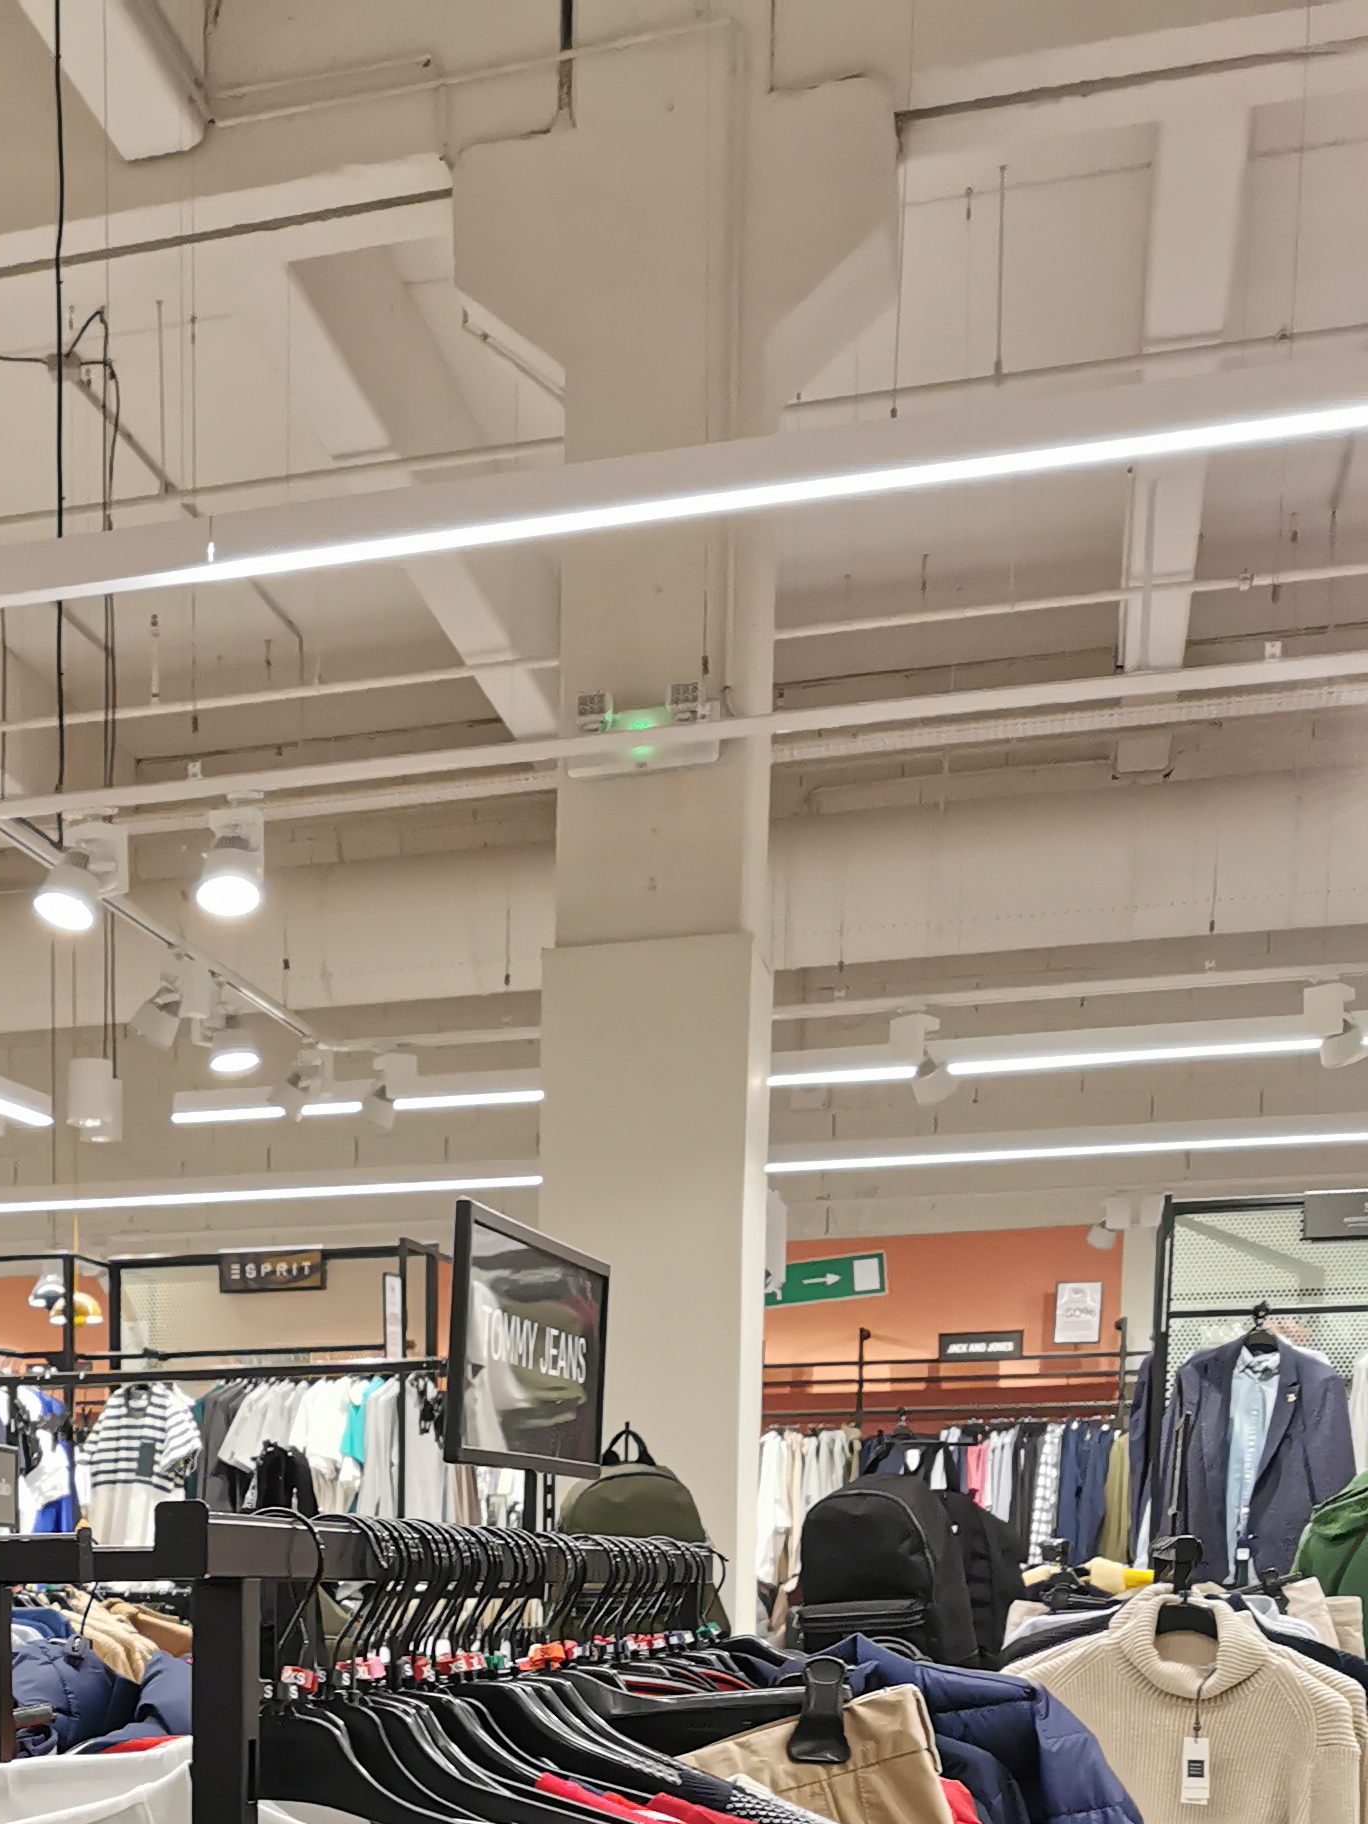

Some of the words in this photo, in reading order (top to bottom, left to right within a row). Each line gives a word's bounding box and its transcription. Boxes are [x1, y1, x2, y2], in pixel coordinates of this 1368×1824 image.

[231, 1261, 312, 1280] ESPRIT
[482, 1305, 538, 1369] TOMMY
[539, 1326, 587, 1384] JEANS
